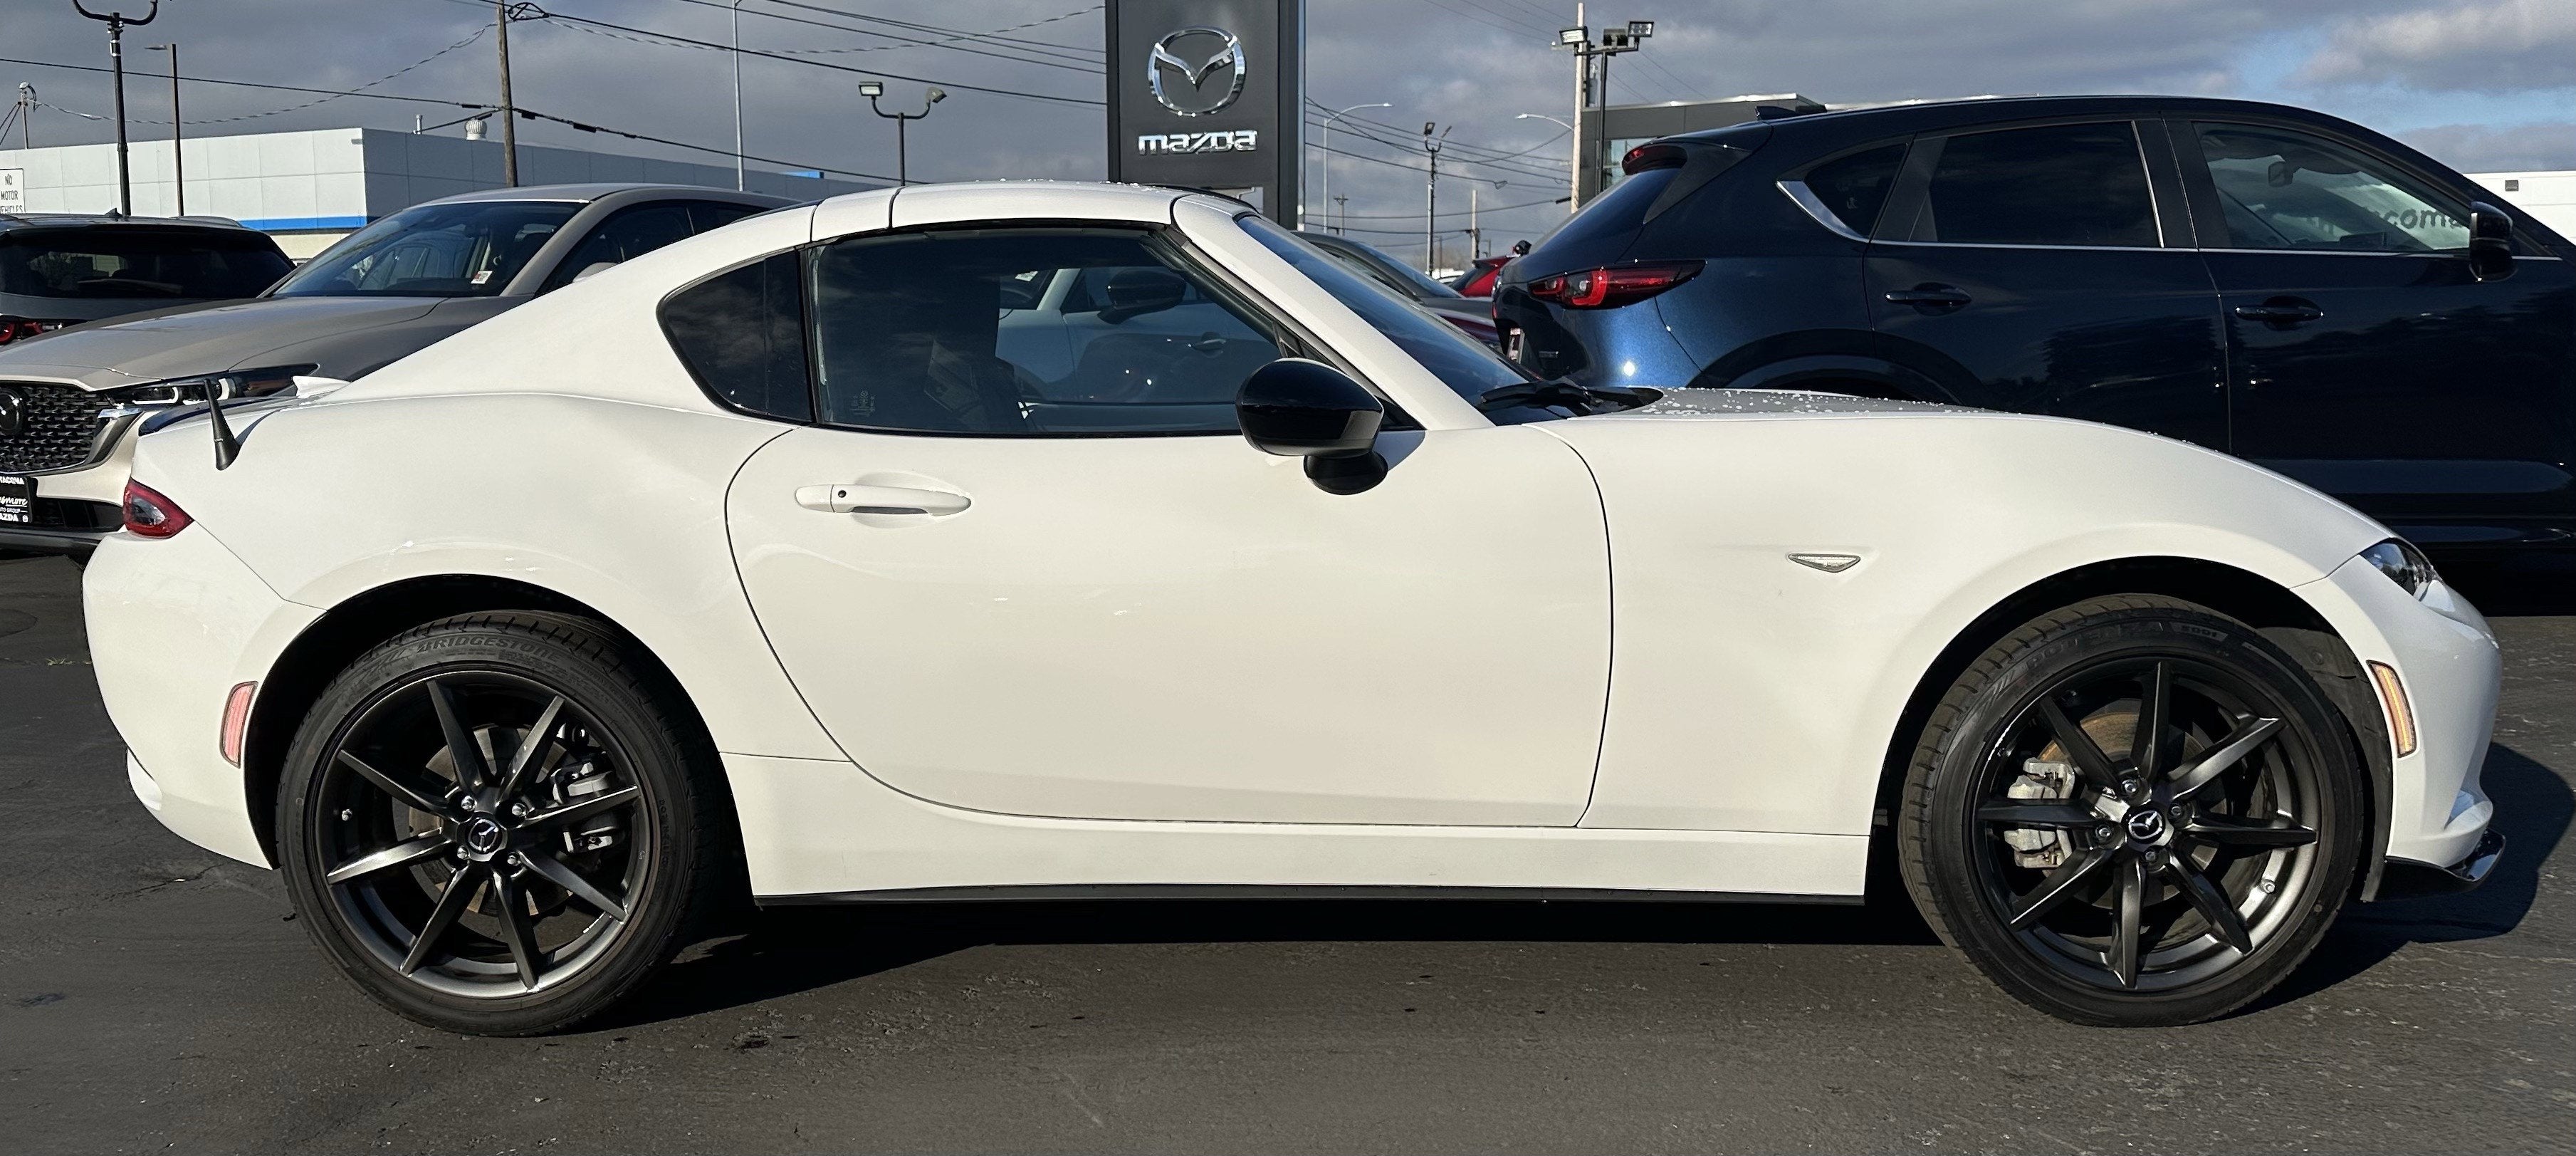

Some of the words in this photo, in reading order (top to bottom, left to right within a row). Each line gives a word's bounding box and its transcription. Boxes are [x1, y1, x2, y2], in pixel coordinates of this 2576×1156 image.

[1138, 130, 1257, 156] mazda
[5, 174, 12, 185] NO
[1, 190, 18, 200] MOTOR
[0, 513, 19, 521] AZDA
[417, 636, 562, 663] BRIDGESTONE
